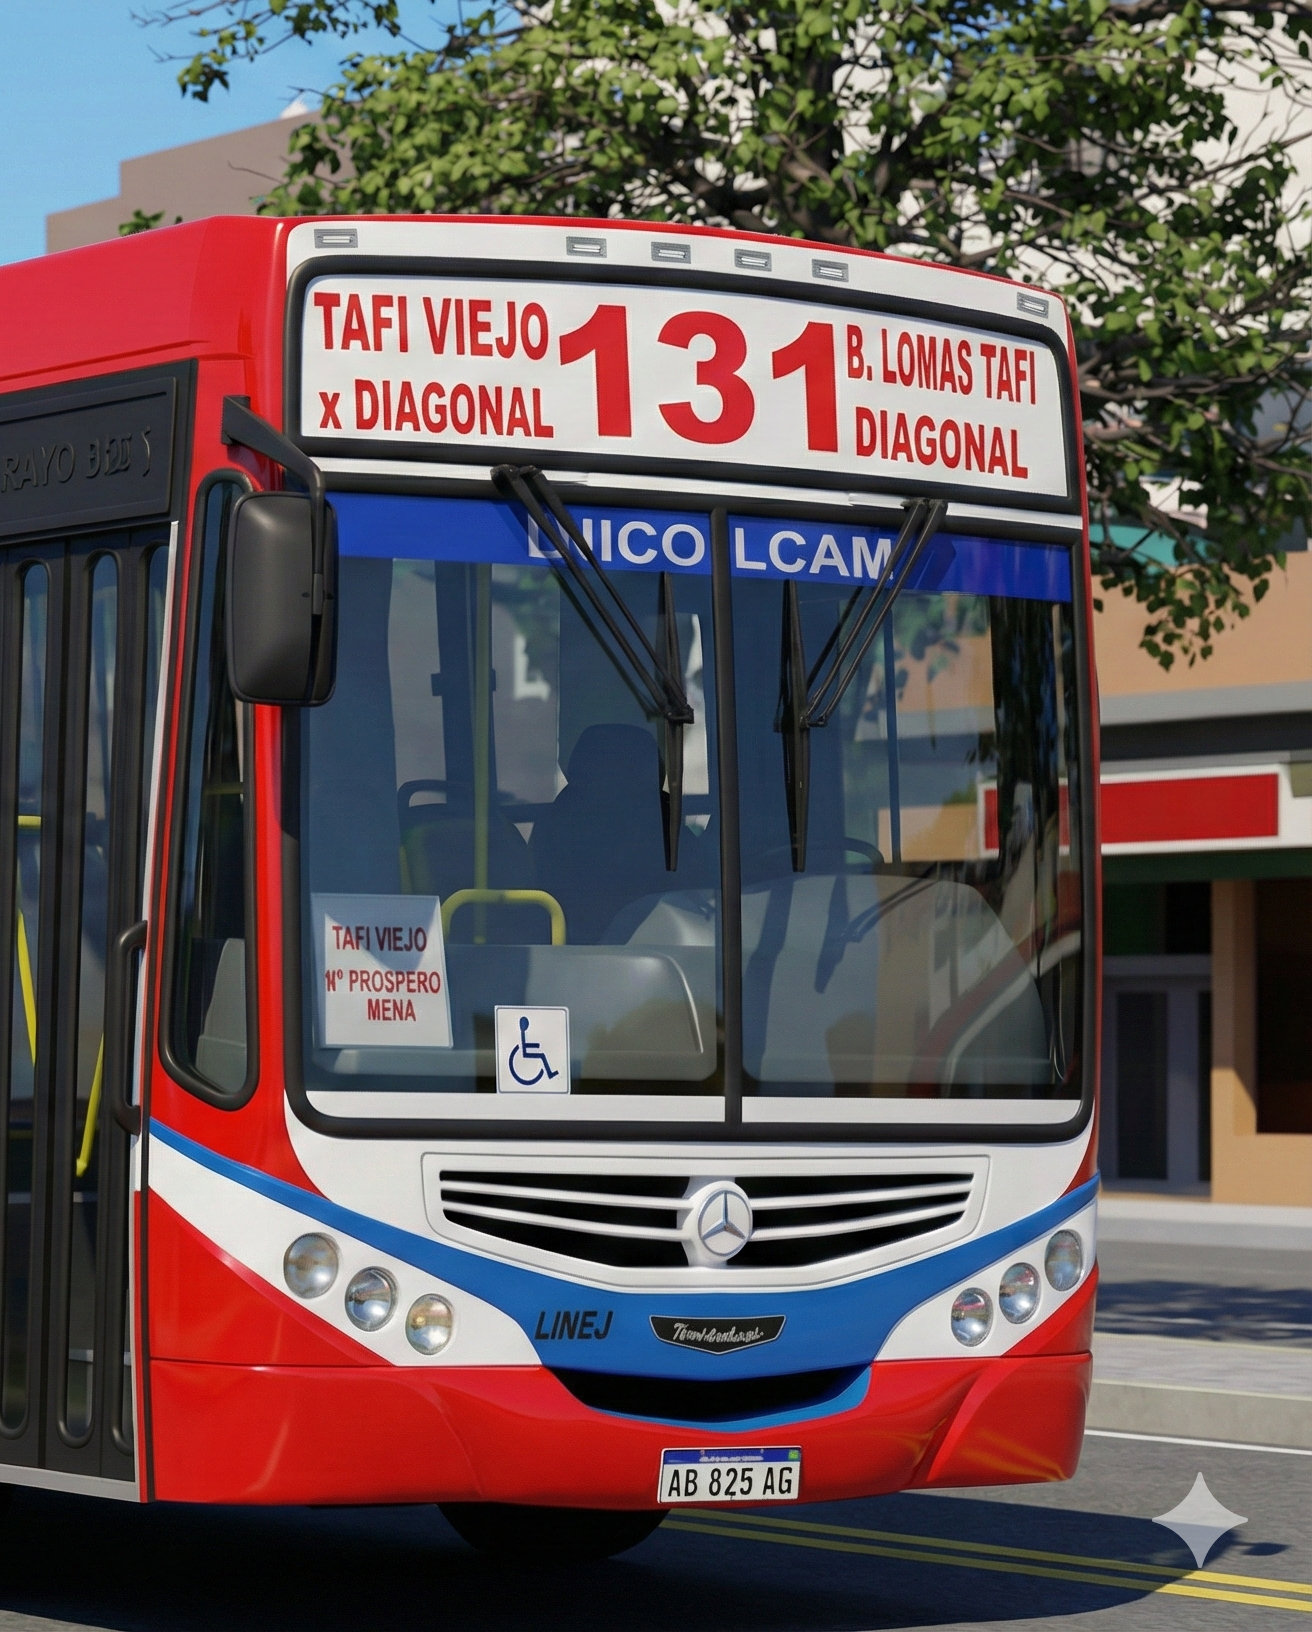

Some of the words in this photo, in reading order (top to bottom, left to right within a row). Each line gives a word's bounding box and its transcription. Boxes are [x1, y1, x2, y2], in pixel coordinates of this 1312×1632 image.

[314, 291, 408, 353] TAFI
[422, 296, 549, 361] VIEJO
[559, 304, 838, 453] 131
[847, 324, 873, 381] B.
[881, 328, 973, 395] LOMAS
[980, 343, 1036, 404] TAFI
[354, 378, 554, 439] DIAGONAL
[0, 442, 76, 493] RAYO
[855, 406, 1028, 479] DIAGONAL
[332, 925, 370, 950] TAFI
[375, 926, 427, 952] VIEJO
[349, 970, 441, 994] PROSPERO
[367, 999, 417, 1022] MENA
[534, 1310, 614, 1340] LINEJ
[668, 1468, 698, 1497] AB
[708, 1467, 754, 1497] 825
[763, 1466, 793, 1496] AG
